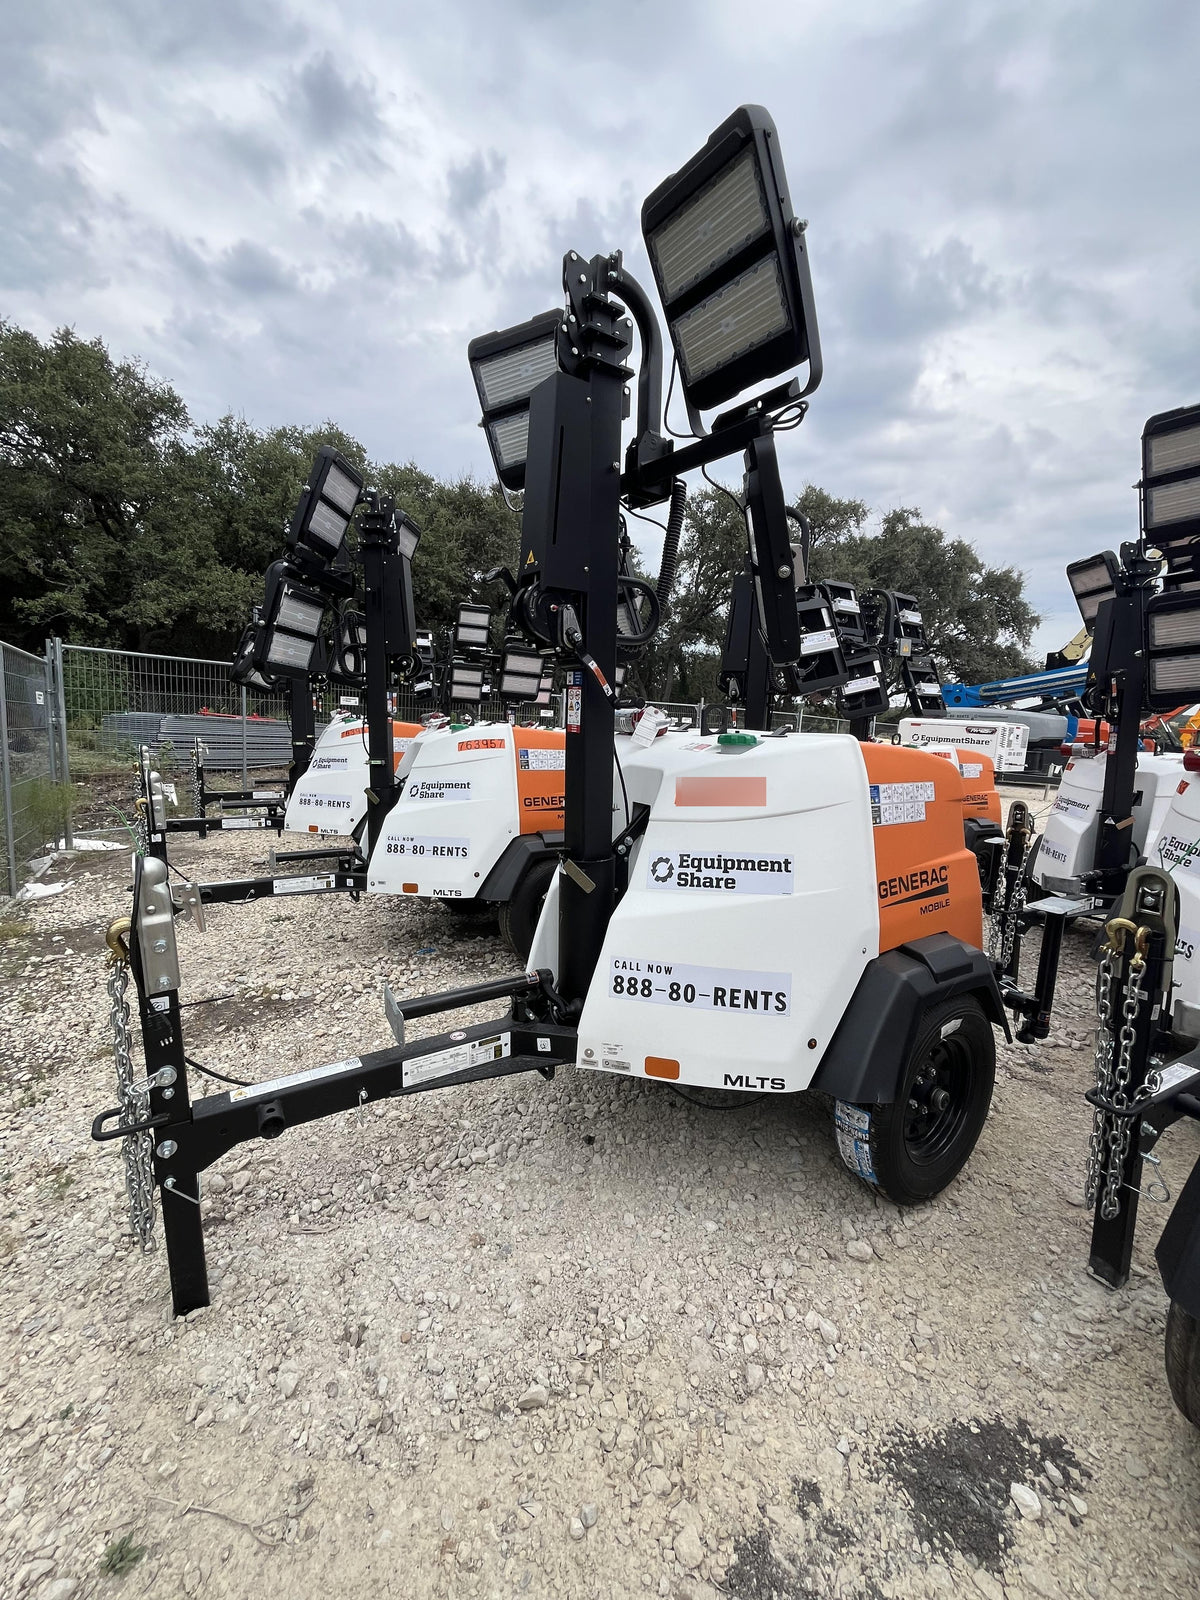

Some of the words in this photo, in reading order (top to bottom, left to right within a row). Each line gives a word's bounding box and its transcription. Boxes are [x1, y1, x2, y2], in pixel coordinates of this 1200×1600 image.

[458, 739, 504, 751] 763957
[920, 735, 990, 745] EquipmentShare
[420, 781, 472, 790] Equipment
[419, 790, 445, 798] Share
[523, 796, 565, 807] GENER
[299, 798, 351, 808] 888-80-RENTS
[386, 843, 468, 857] 888-80-RENTS
[1163, 848, 1192, 867] Share
[678, 853, 792, 873] Equipment
[676, 872, 736, 889] Share
[878, 865, 948, 900] GENERAC
[919, 898, 950, 915] MOBILE
[614, 960, 641, 972] CALL
[647, 964, 673, 975] NOW
[613, 975, 787, 1012] 888-80-RENTS
[723, 1073, 786, 1090] MLTS
